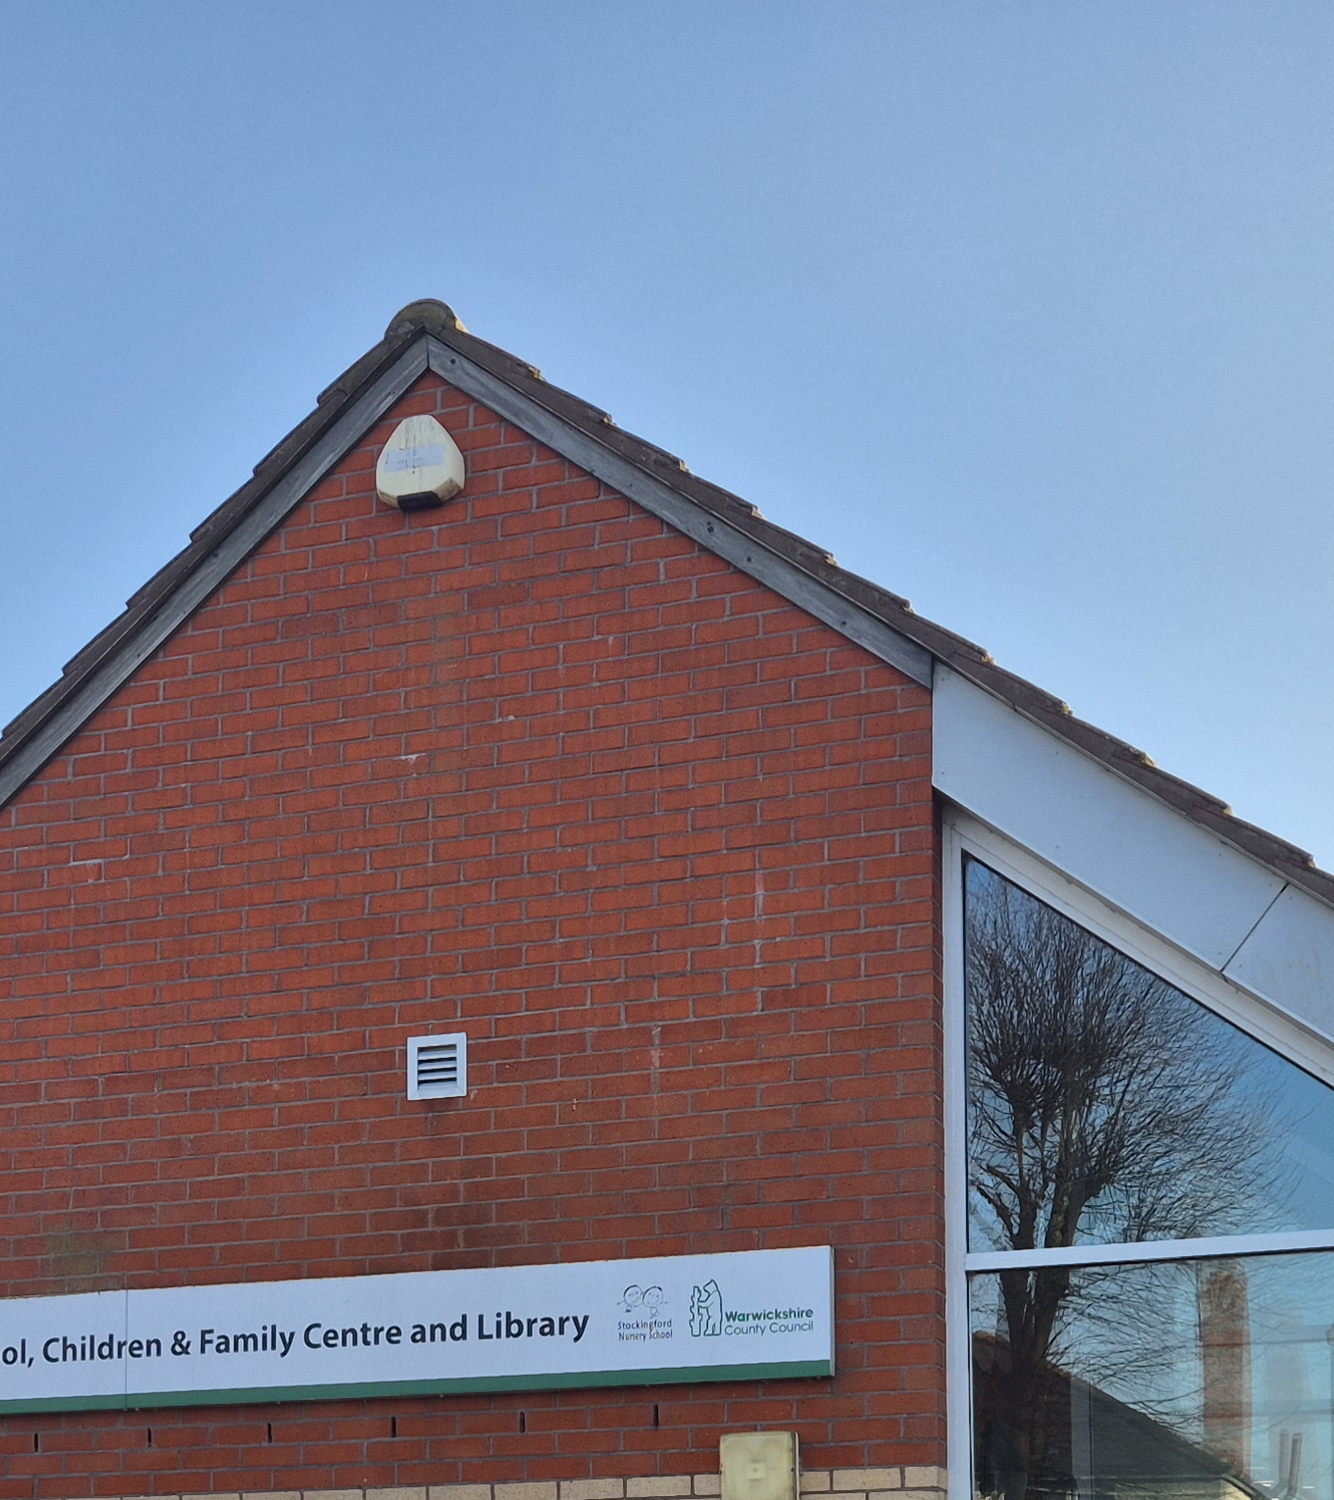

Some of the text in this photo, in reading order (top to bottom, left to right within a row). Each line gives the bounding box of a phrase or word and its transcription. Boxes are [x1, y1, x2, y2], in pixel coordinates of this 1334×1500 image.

[724, 1307, 814, 1323] Warwickshire
[617, 1318, 672, 1333] Stockingford
[724, 1321, 814, 1336] County Council
[42, 1333, 163, 1363] Children
[170, 1330, 192, 1356] &
[200, 1324, 296, 1358] Family
[303, 1322, 403, 1349] Centre
[410, 1313, 468, 1343] and
[478, 1311, 590, 1344] Library
[618, 1330, 673, 1342] Nursery School
